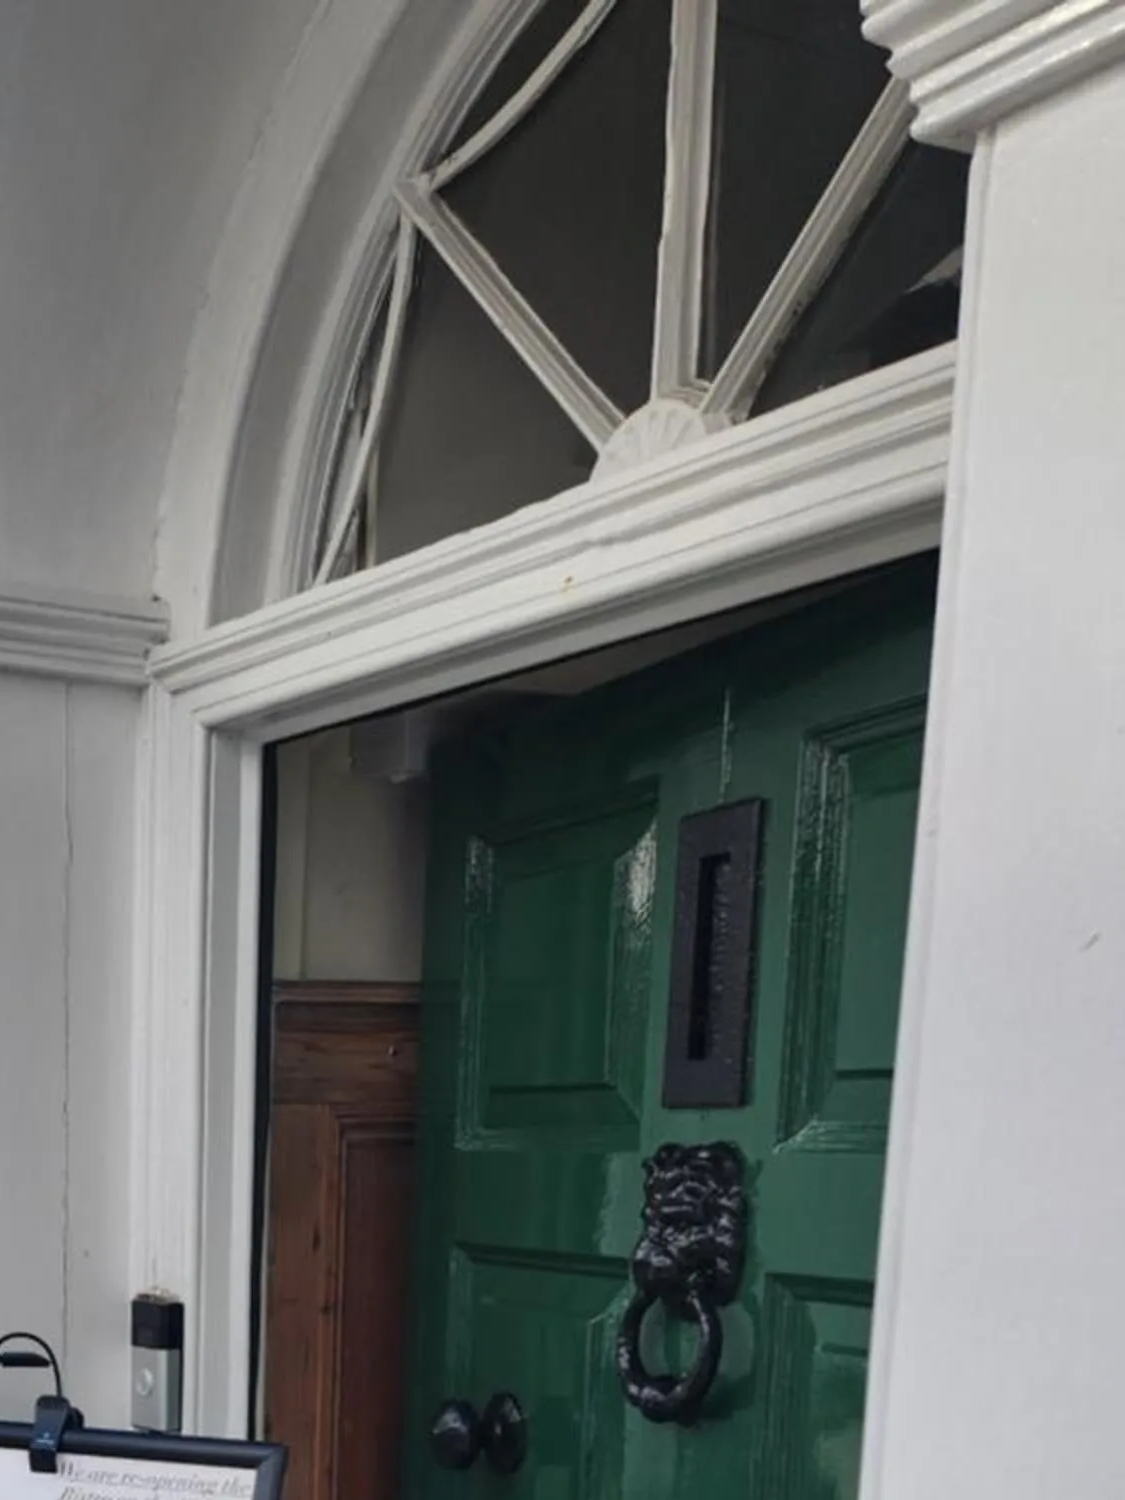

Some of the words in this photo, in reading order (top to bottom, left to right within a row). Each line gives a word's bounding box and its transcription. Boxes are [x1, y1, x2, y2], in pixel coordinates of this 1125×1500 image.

[58, 1459, 83, 1481] We
[85, 1469, 115, 1484] are
[220, 1475, 252, 1496] the
